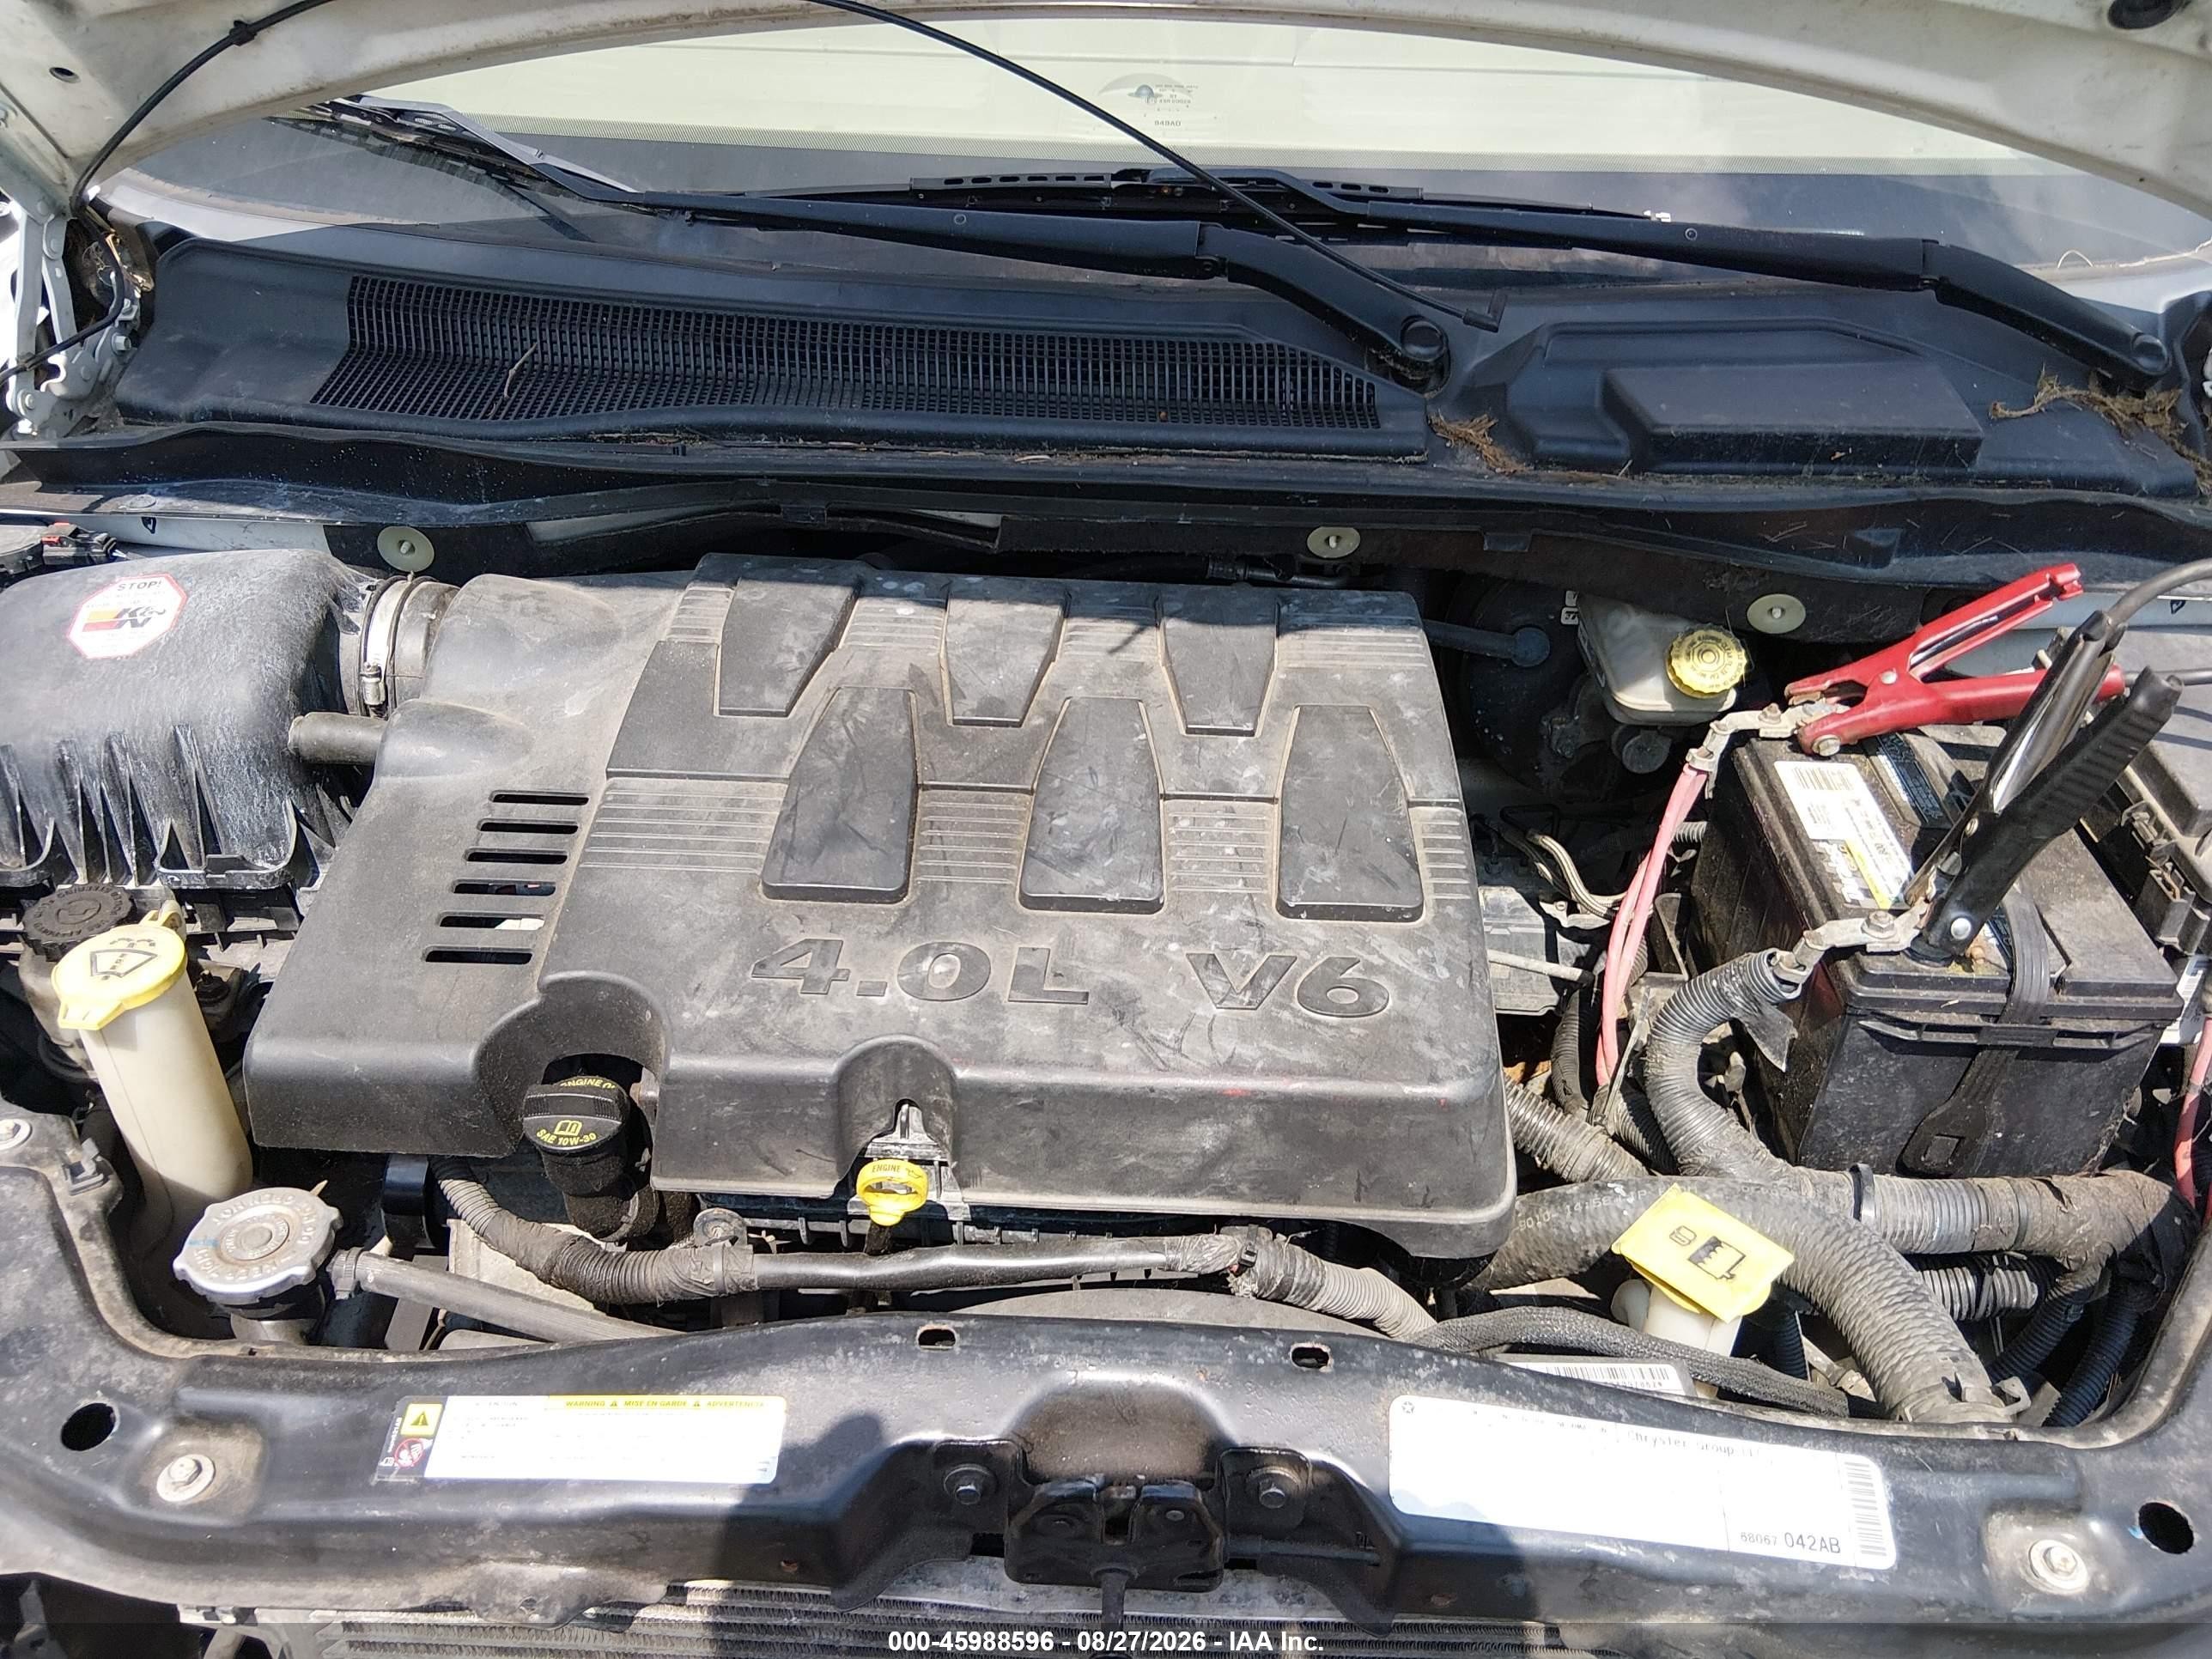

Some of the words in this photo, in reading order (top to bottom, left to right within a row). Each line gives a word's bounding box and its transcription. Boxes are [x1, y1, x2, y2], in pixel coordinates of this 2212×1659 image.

[117, 580, 163, 592] STOP!
[751, 938, 1090, 1005] 4.0L
[1185, 952, 1390, 1018] V6
[536, 1128, 557, 1144] SAE
[557, 1132, 597, 1146] 10W-30
[872, 1164, 901, 1173] ENGINE
[706, 1400, 764, 1408] ADVERTENCIA
[1784, 1531, 1842, 1554] 042AB
